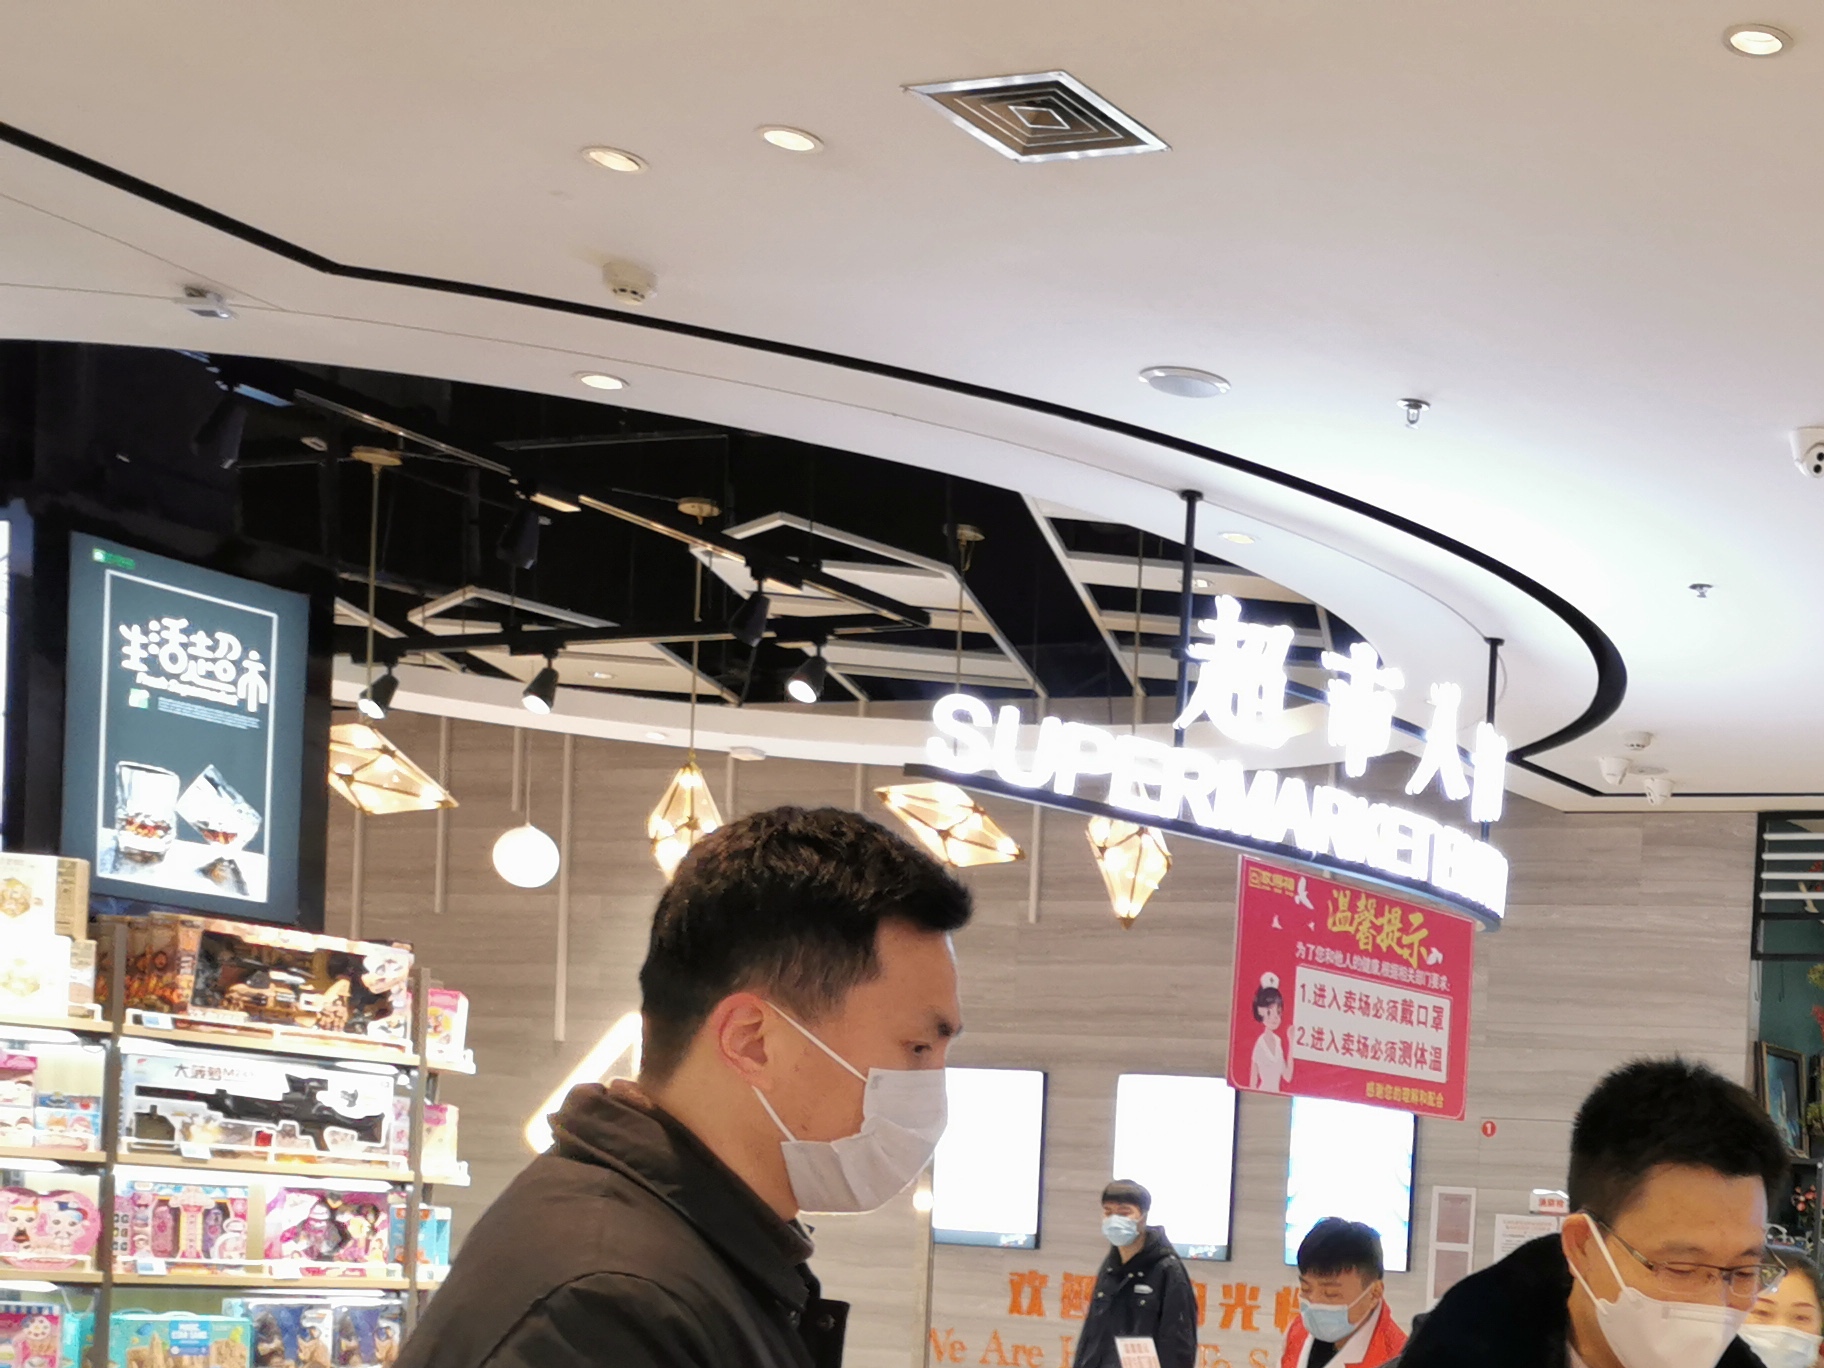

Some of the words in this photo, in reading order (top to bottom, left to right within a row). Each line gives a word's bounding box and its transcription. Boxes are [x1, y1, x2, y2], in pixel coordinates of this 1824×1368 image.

[119, 617, 268, 713] 生活超市
[1327, 889, 1428, 968] 温馨提示
[1299, 983, 1444, 1032] 1.进入卖场必须戴口罩
[1296, 1026, 1443, 1073] 2.进入卖场必须测体温
[980, 1329, 1043, 1368] Are
